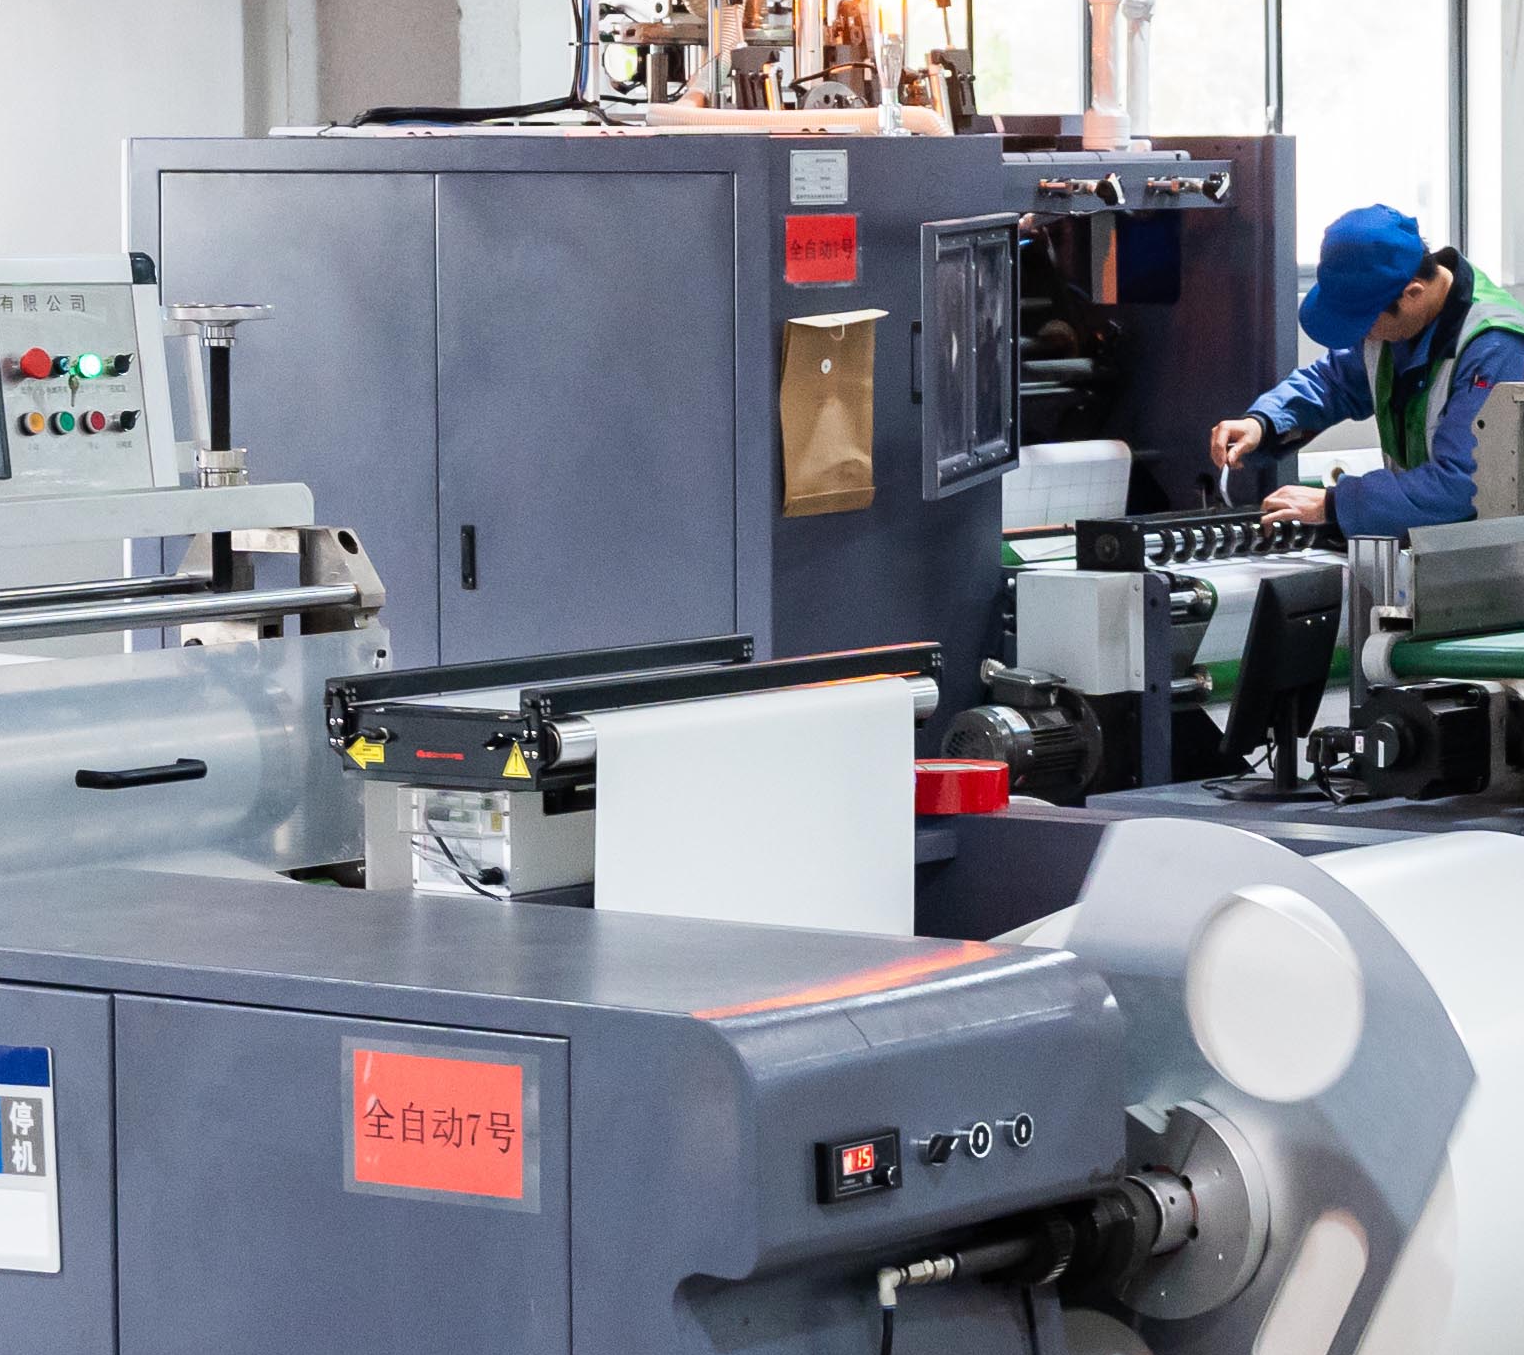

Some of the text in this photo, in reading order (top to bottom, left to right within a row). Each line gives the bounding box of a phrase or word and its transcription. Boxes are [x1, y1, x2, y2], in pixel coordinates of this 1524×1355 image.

[8, 1101, 37, 1174] 停机
[362, 1098, 516, 1154] 全自动7号
